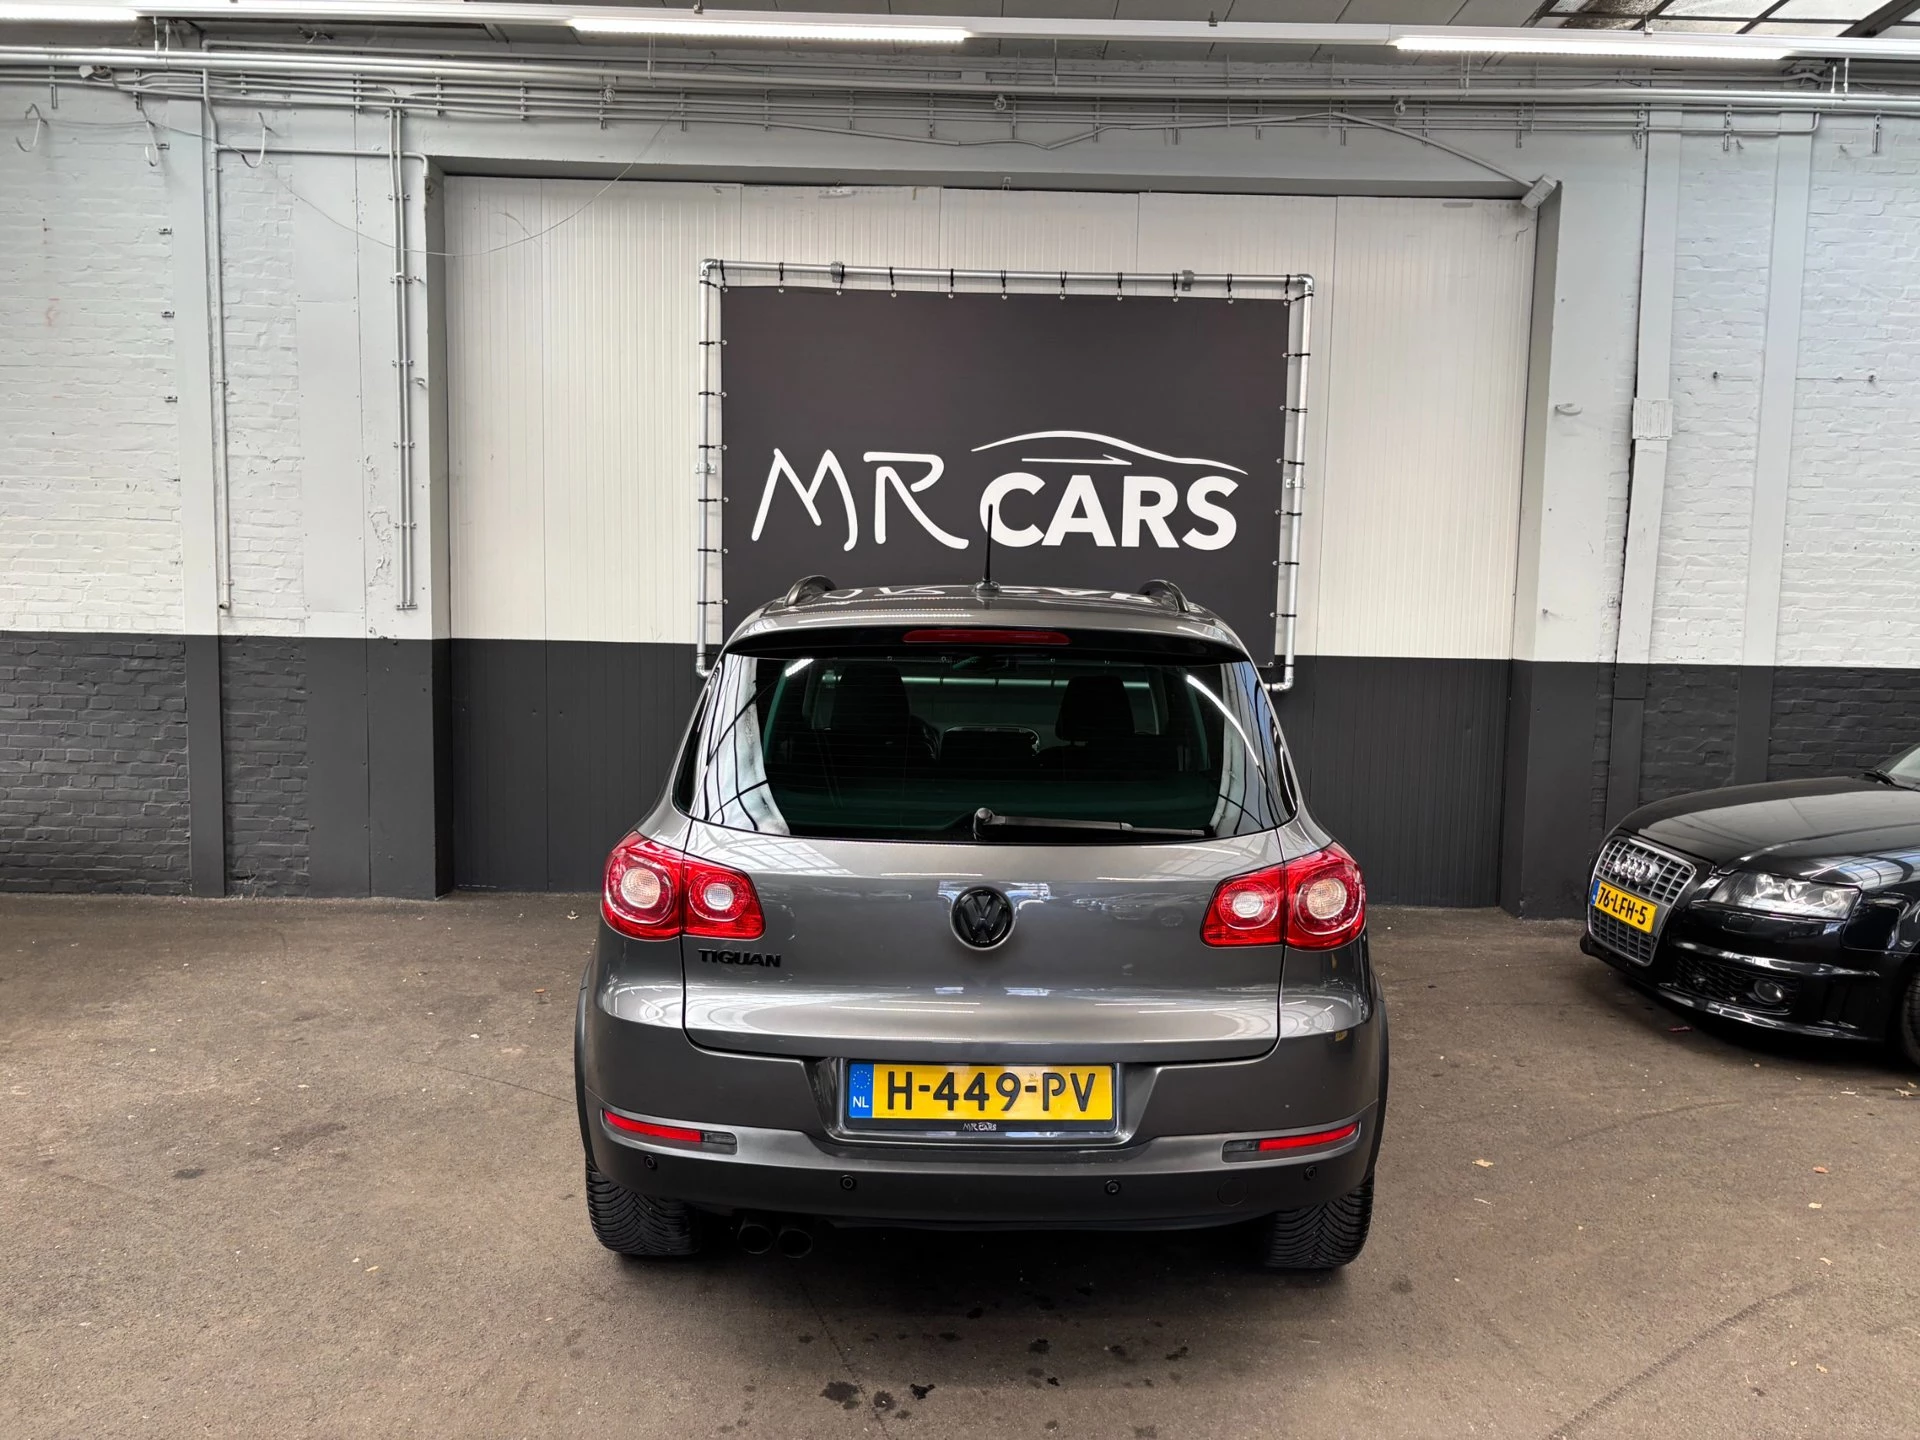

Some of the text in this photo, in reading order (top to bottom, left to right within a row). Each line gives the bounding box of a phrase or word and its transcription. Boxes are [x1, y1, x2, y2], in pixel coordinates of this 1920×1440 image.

[751, 447, 1240, 552] MR CARS
[1597, 886, 1649, 925] 76-LFH-5
[697, 948, 782, 968] TIGUAN
[852, 1096, 870, 1109] NL
[887, 1071, 1096, 1112] H-449-PV
[978, 1123, 997, 1131] CARS
